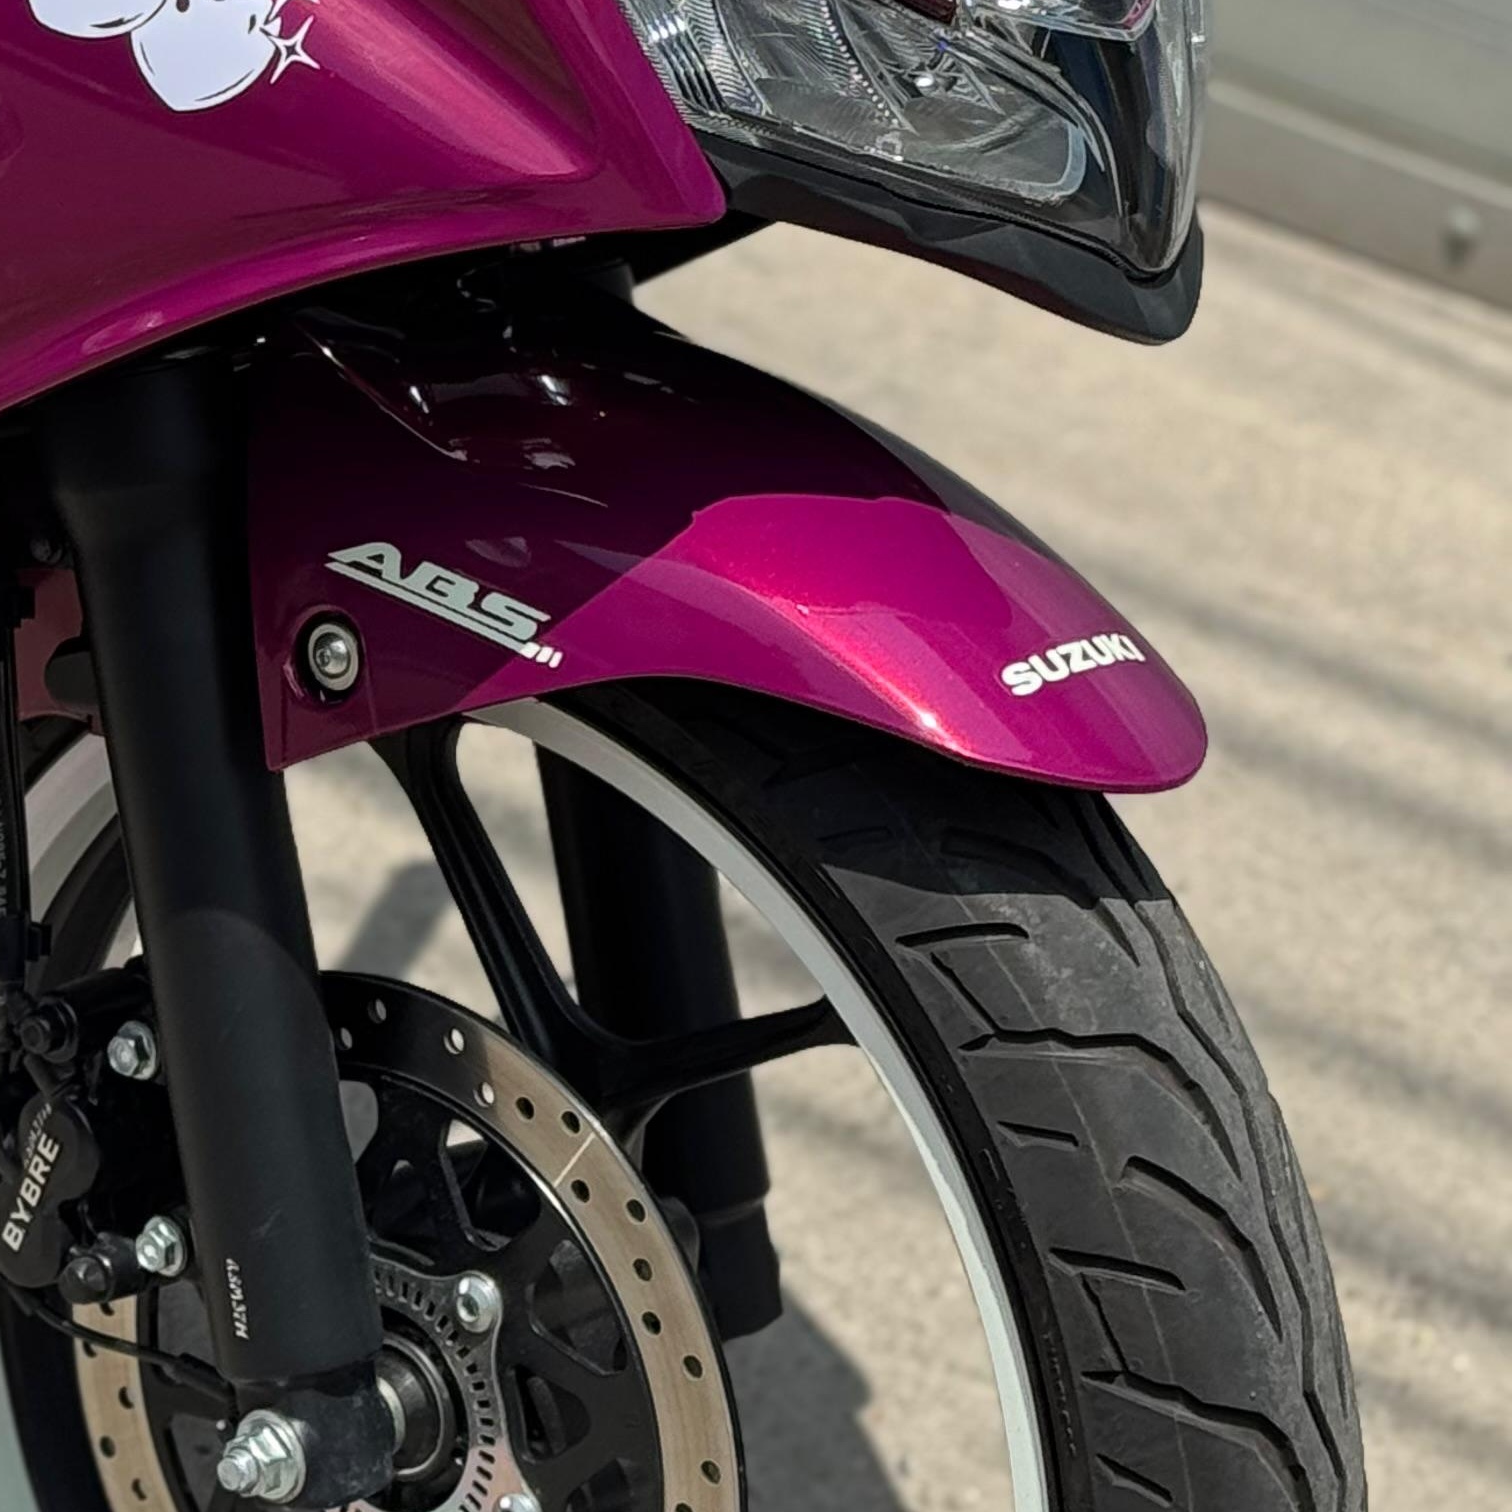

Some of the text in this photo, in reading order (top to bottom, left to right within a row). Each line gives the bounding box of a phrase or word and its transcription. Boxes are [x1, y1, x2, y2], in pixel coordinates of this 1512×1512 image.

[327, 541, 552, 642] ABS
[1001, 632, 1146, 696] SUZUKI
[1, 1133, 60, 1252] BYBRE
